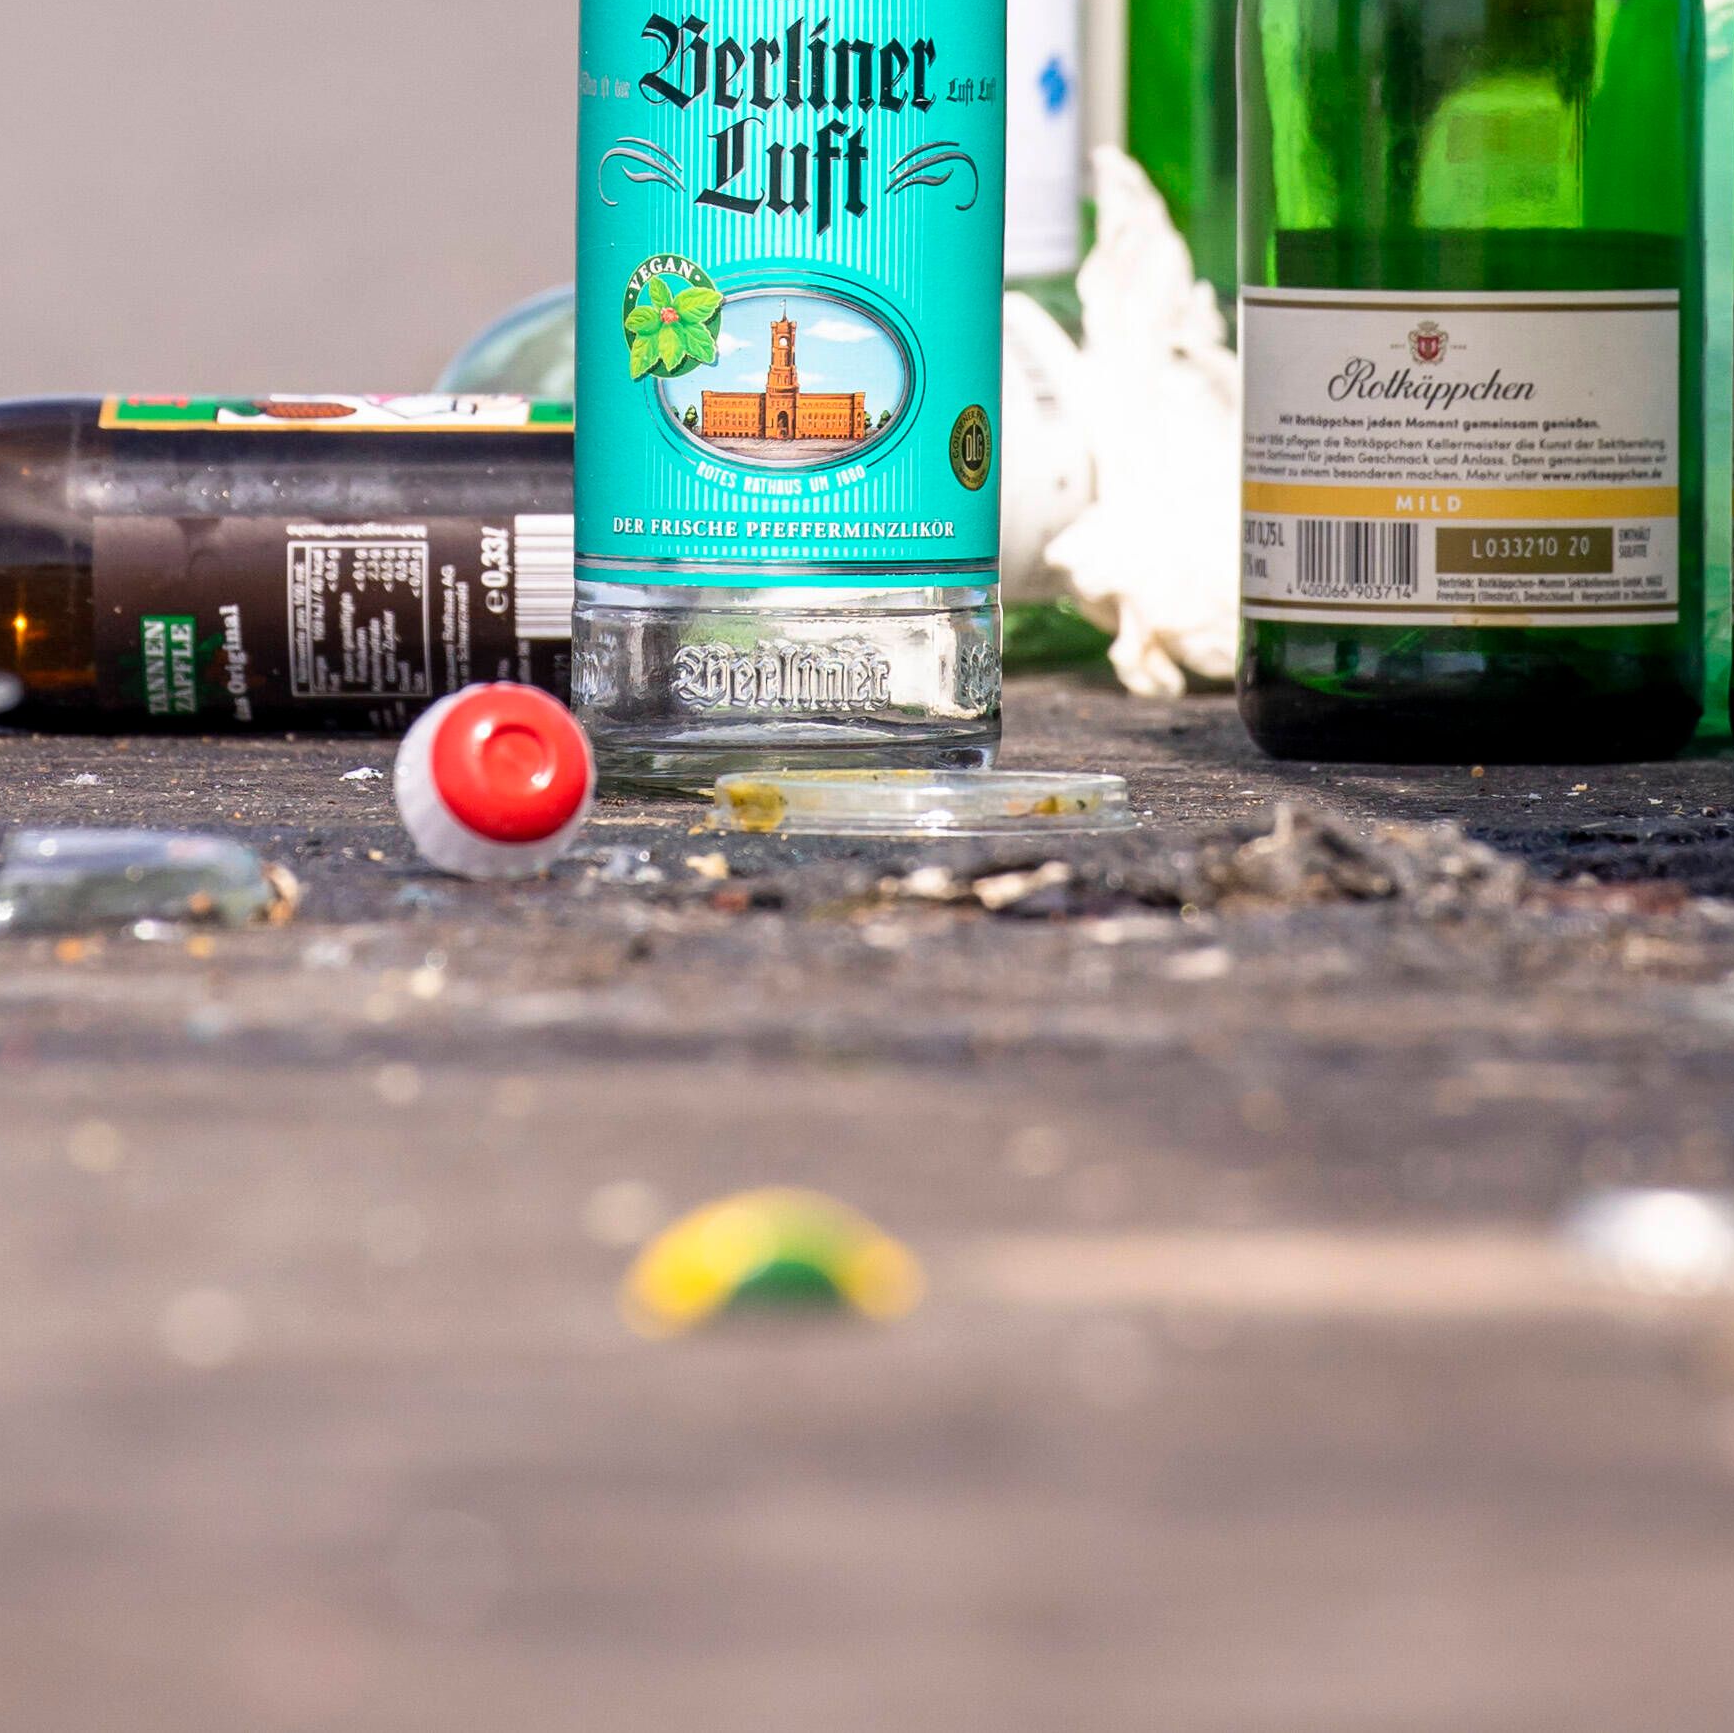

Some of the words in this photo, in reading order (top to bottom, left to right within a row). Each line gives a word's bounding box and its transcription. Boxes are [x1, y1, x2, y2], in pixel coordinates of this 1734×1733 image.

[638, 12, 937, 113] Berliner
[693, 117, 869, 236] Luft
[628, 256, 696, 291] VEGAN
[1327, 356, 1536, 410] Rotkäppchen
[1295, 415, 1364, 430] Rotkäppchen
[1366, 417, 1401, 431] jeden
[1405, 417, 1458, 429] Moment
[1463, 418, 1538, 432] gemeinsam
[1542, 418, 1601, 432] genießen.
[1286, 435, 1321, 450] pflegen
[1324, 436, 1340, 448] die
[1344, 437, 1423, 451] Rotkäppchen
[1426, 438, 1512, 450] Kellermeister
[1515, 439, 1535, 450] die
[1539, 438, 1572, 450] Kunst
[1575, 438, 1594, 450] der
[1324, 451, 1355, 465] jeden
[1358, 452, 1429, 465] Geschmack
[1434, 453, 1458, 465] und
[1461, 454, 1504, 466] Anlass.
[1511, 454, 1545, 465] Denn
[1548, 454, 1615, 468] gemeinsam
[696, 460, 738, 489] ROTES
[743, 474, 803, 496] RATHAUS
[809, 475, 830, 493] UM
[1301, 466, 1330, 478] einem
[1333, 467, 1403, 479] besonderen
[1406, 468, 1462, 480] machen.
[1466, 469, 1502, 481] Mehr
[1504, 469, 1539, 482] unter
[1394, 494, 1463, 512] MILD
[613, 516, 645, 535] DER
[651, 518, 738, 538] FRISCHE
[746, 517, 956, 539] PFEFFERMINZLIKÖR
[1471, 536, 1558, 559] L033210
[1300, 581, 1349, 599] 400066
[1355, 585, 1412, 600] 903714
[219, 603, 247, 693] Original
